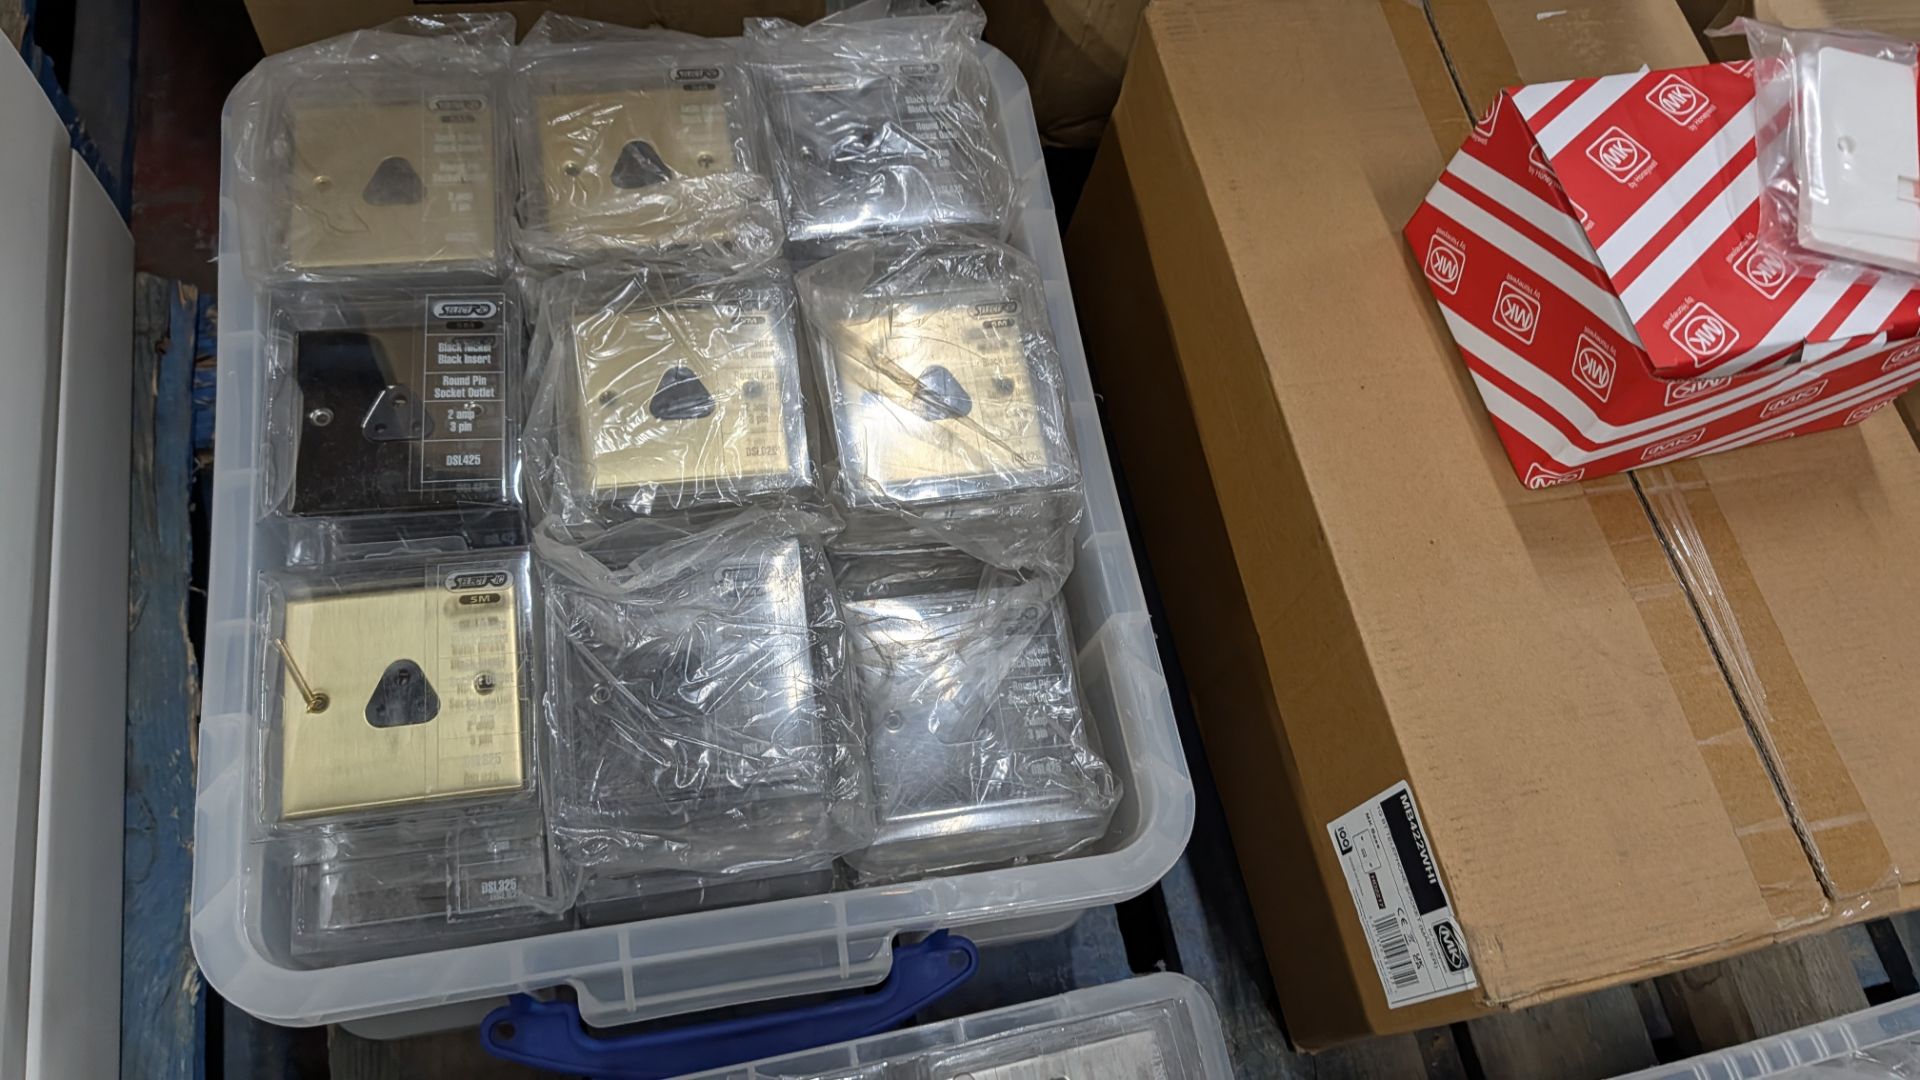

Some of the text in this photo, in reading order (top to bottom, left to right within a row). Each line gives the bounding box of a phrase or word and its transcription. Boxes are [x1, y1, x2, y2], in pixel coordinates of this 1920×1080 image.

[1663, 86, 1692, 112] MK
[1602, 140, 1633, 168] MK
[1434, 251, 1456, 279] MK
[1504, 298, 1531, 329] MK
[438, 342, 462, 352] Black
[1689, 317, 1722, 352] MK
[438, 354, 491, 364] Black Insert
[1583, 352, 1607, 385] MK
[434, 387, 495, 398] Socket Outlet
[443, 375, 487, 386] Round Pin
[448, 409, 475, 420] 2 amp
[450, 421, 472, 433] 3 pin
[446, 454, 481, 466] DSL425
[1400, 794, 1437, 884] MB422WHI
[1441, 928, 1461, 963] MK
